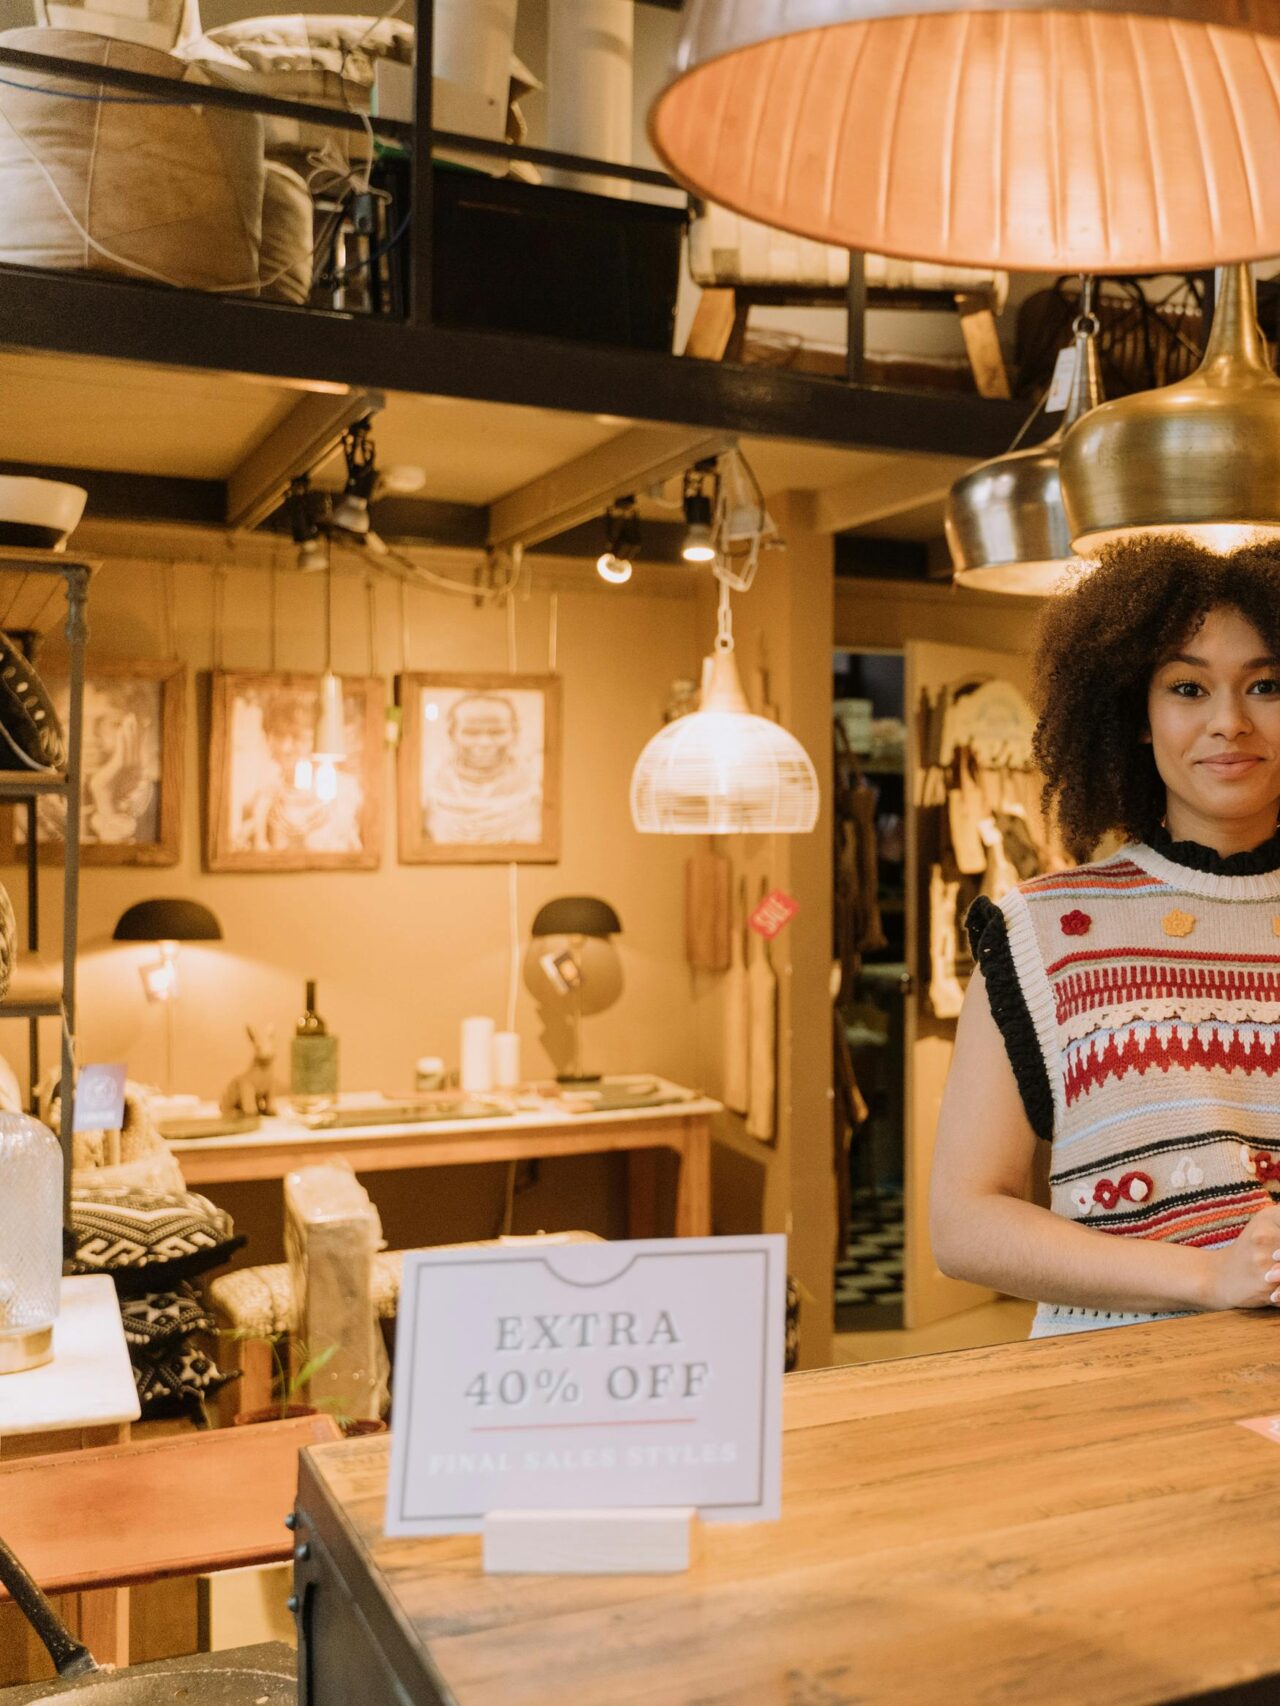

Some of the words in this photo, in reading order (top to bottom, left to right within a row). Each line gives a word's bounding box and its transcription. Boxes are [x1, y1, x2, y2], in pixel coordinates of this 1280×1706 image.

[753, 896, 793, 934] SALE
[494, 1309, 683, 1352] EXTRA
[463, 1367, 581, 1408] 40%
[606, 1361, 711, 1401] OFF
[428, 1452, 513, 1476] FINAL
[524, 1446, 617, 1471] SALES
[626, 1441, 738, 1468] STYLES
